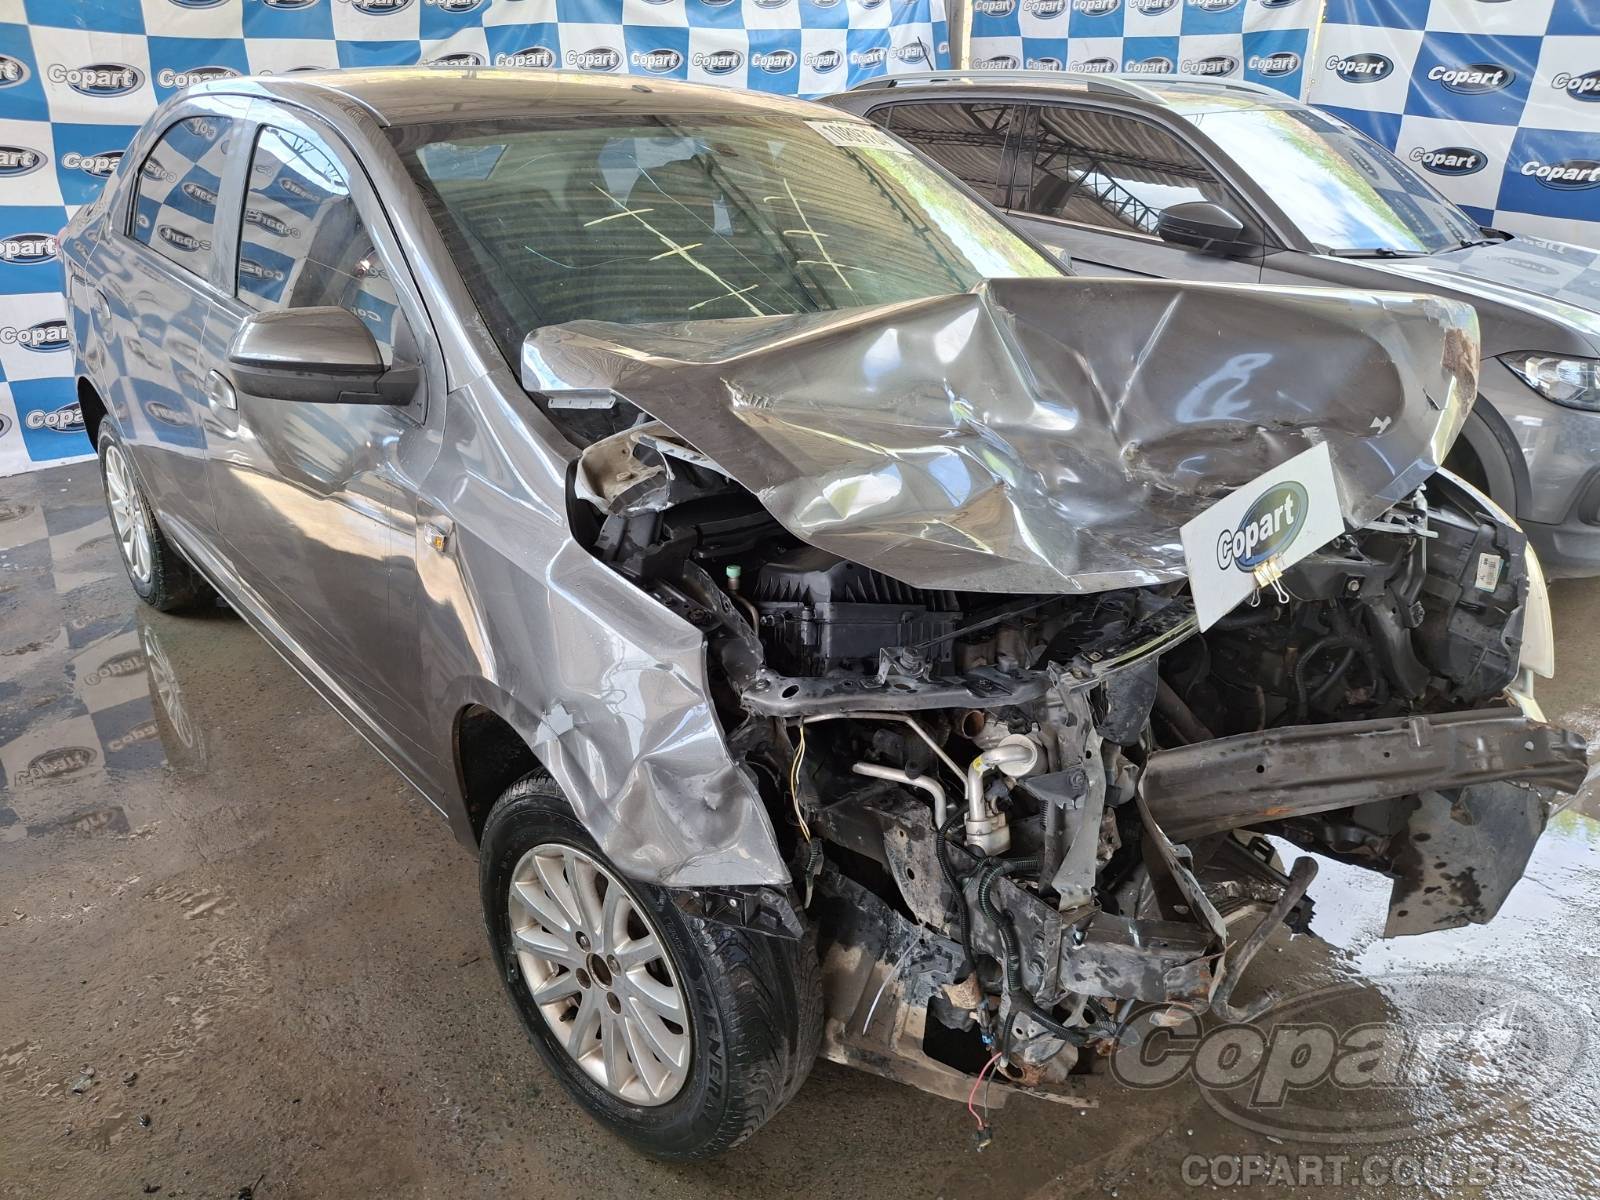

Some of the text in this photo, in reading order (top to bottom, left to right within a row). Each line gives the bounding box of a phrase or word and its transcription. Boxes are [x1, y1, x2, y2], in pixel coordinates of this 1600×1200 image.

[1023, 0, 1062, 12] Copart
[1072, 0, 1114, 11] Copart
[495, 51, 550, 67] Copart
[566, 50, 616, 70] Copart
[631, 51, 678, 70] Copart
[692, 53, 741, 71] Copart
[752, 53, 794, 70] Copart
[803, 52, 838, 70] Copart
[973, 58, 1013, 69] Copart
[1070, 61, 1112, 73] Copart
[1125, 60, 1168, 73] Copart
[1181, 58, 1231, 76] Copart
[1249, 55, 1297, 73] Copart
[1326, 55, 1385, 75] Copart
[48, 63, 135, 88] Copart
[1427, 66, 1504, 86] Copart
[62, 152, 119, 173] Copa
[1409, 147, 1477, 169] Copart
[0, 326, 68, 346] Copar
[26, 409, 84, 429] Copa
[1217, 493, 1295, 571] Copart
